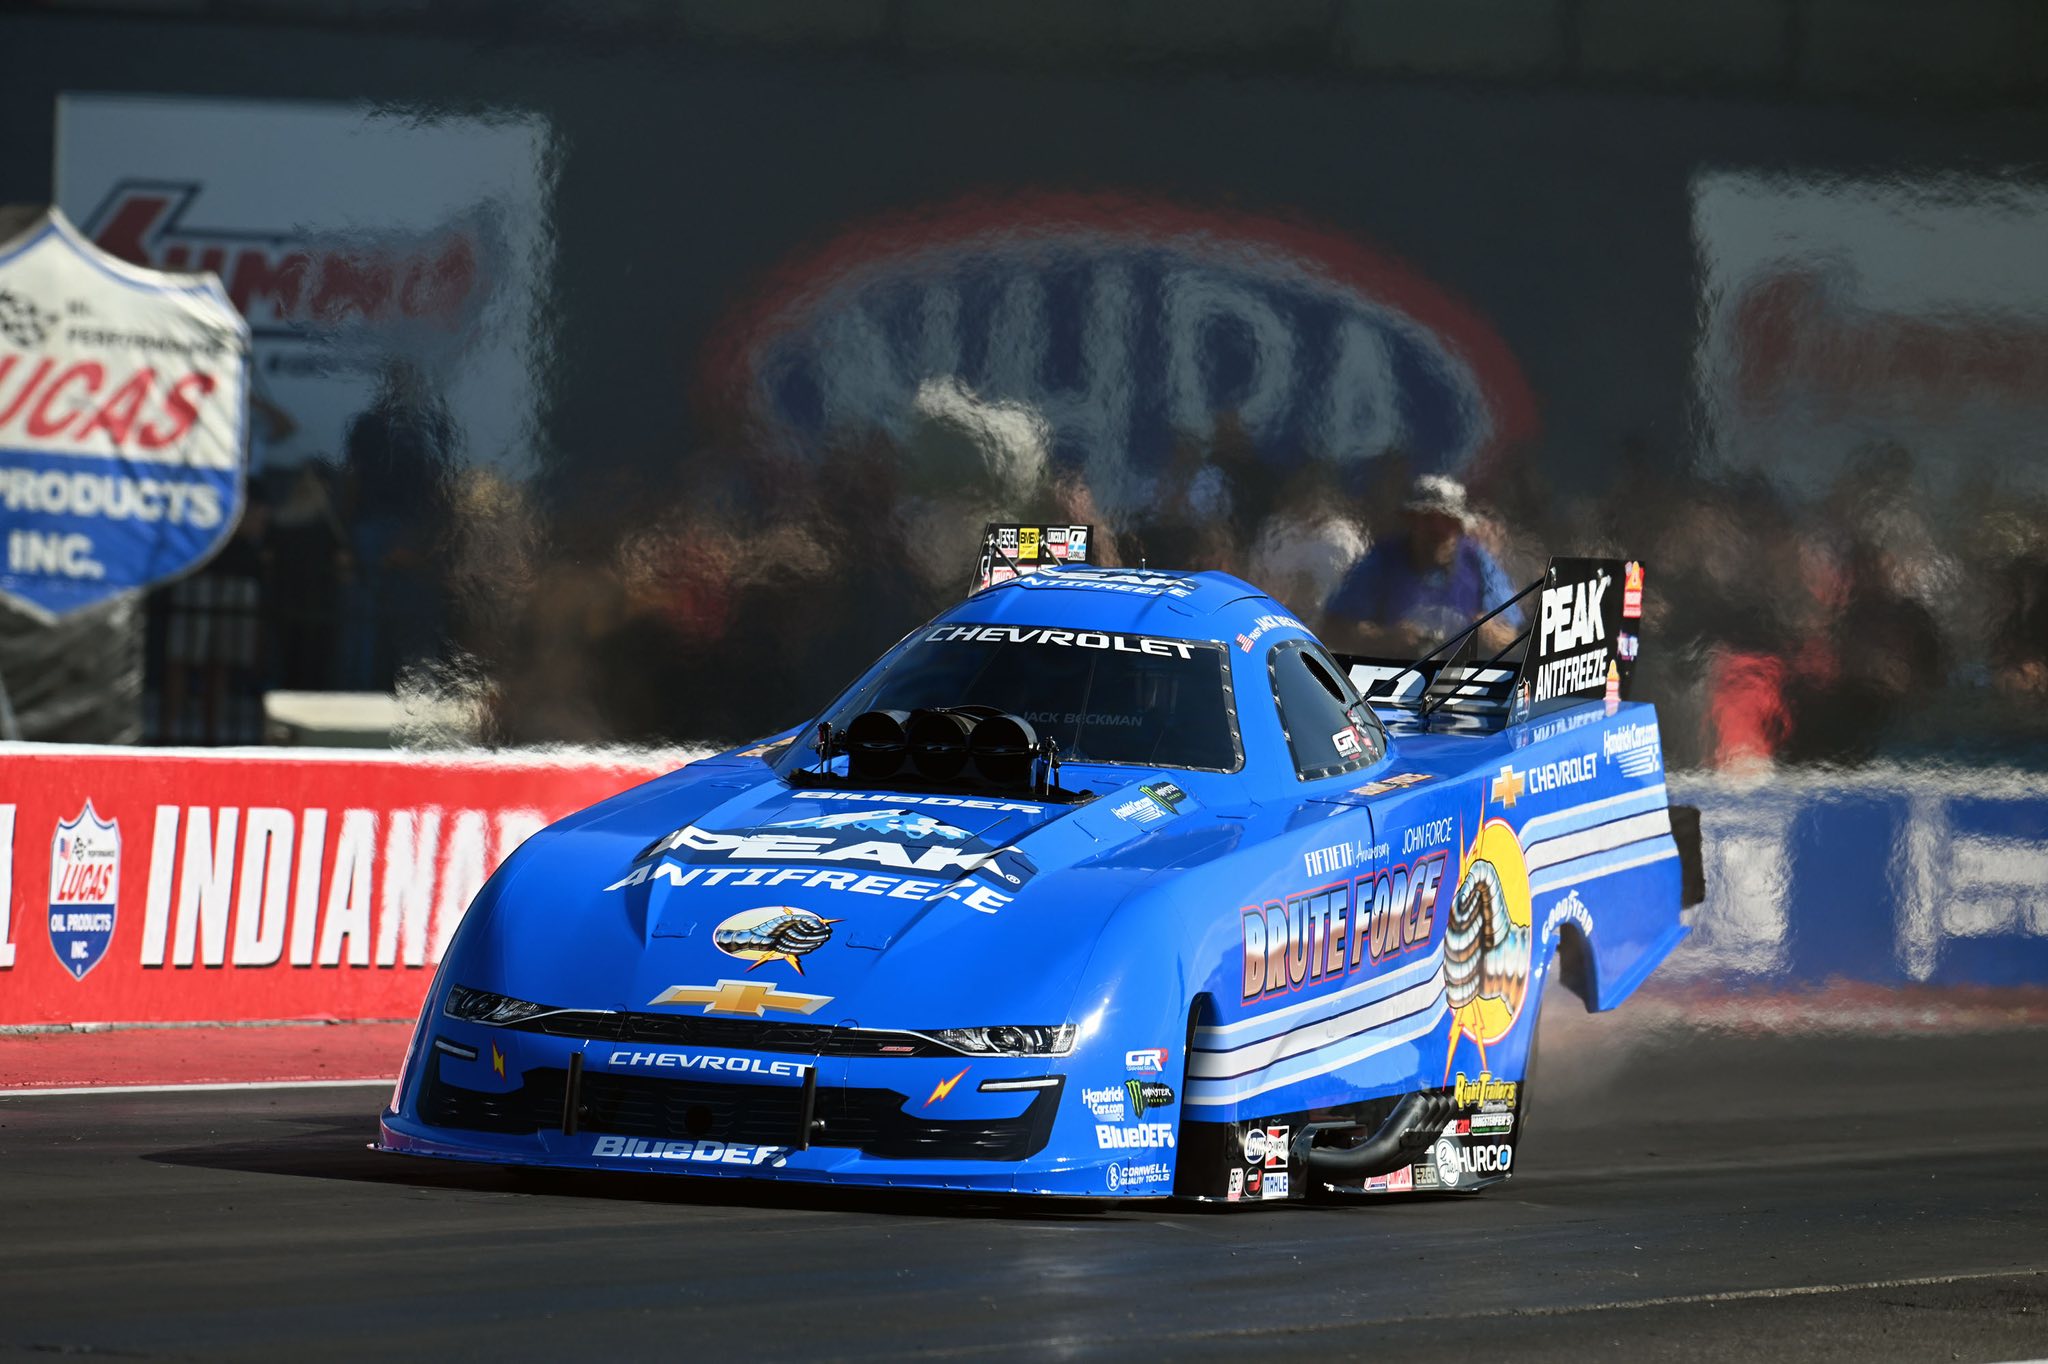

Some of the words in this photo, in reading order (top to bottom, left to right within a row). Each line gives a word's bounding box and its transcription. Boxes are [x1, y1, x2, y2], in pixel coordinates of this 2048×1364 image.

[0, 352, 218, 450] UCAS
[8, 530, 105, 580] INC.
[1539, 576, 1606, 657] PEAK
[925, 626, 1195, 659] CHEVROLET
[1535, 647, 1608, 703] ANTIFREEZE
[1529, 752, 1598, 794] CHEVROLET
[649, 825, 1024, 879] PEAK
[1402, 827, 1425, 855] JOHN
[1424, 817, 1453, 848] FORCE
[1304, 842, 1354, 878] FIFTIETH
[57, 863, 113, 901] LUCAS
[602, 862, 1015, 914] ANTIFREEZE
[51, 914, 66, 932] OIL
[67, 914, 112, 932] PRODUCTS
[1241, 881, 1349, 1004] BRUTE
[1350, 851, 1448, 973] FORCE
[609, 1052, 813, 1078] CHEVROLET
[1082, 1086, 1124, 1108] Hendrick
[1142, 1086, 1171, 1097] MONSTER
[1095, 1123, 1172, 1149] BlueDEF
[1121, 1163, 1169, 1177] CORNWELL
[1456, 1144, 1512, 1173] HURCO
[1120, 1176, 1144, 1185] QUALITY
[1145, 1173, 1170, 1183] TOOLS
